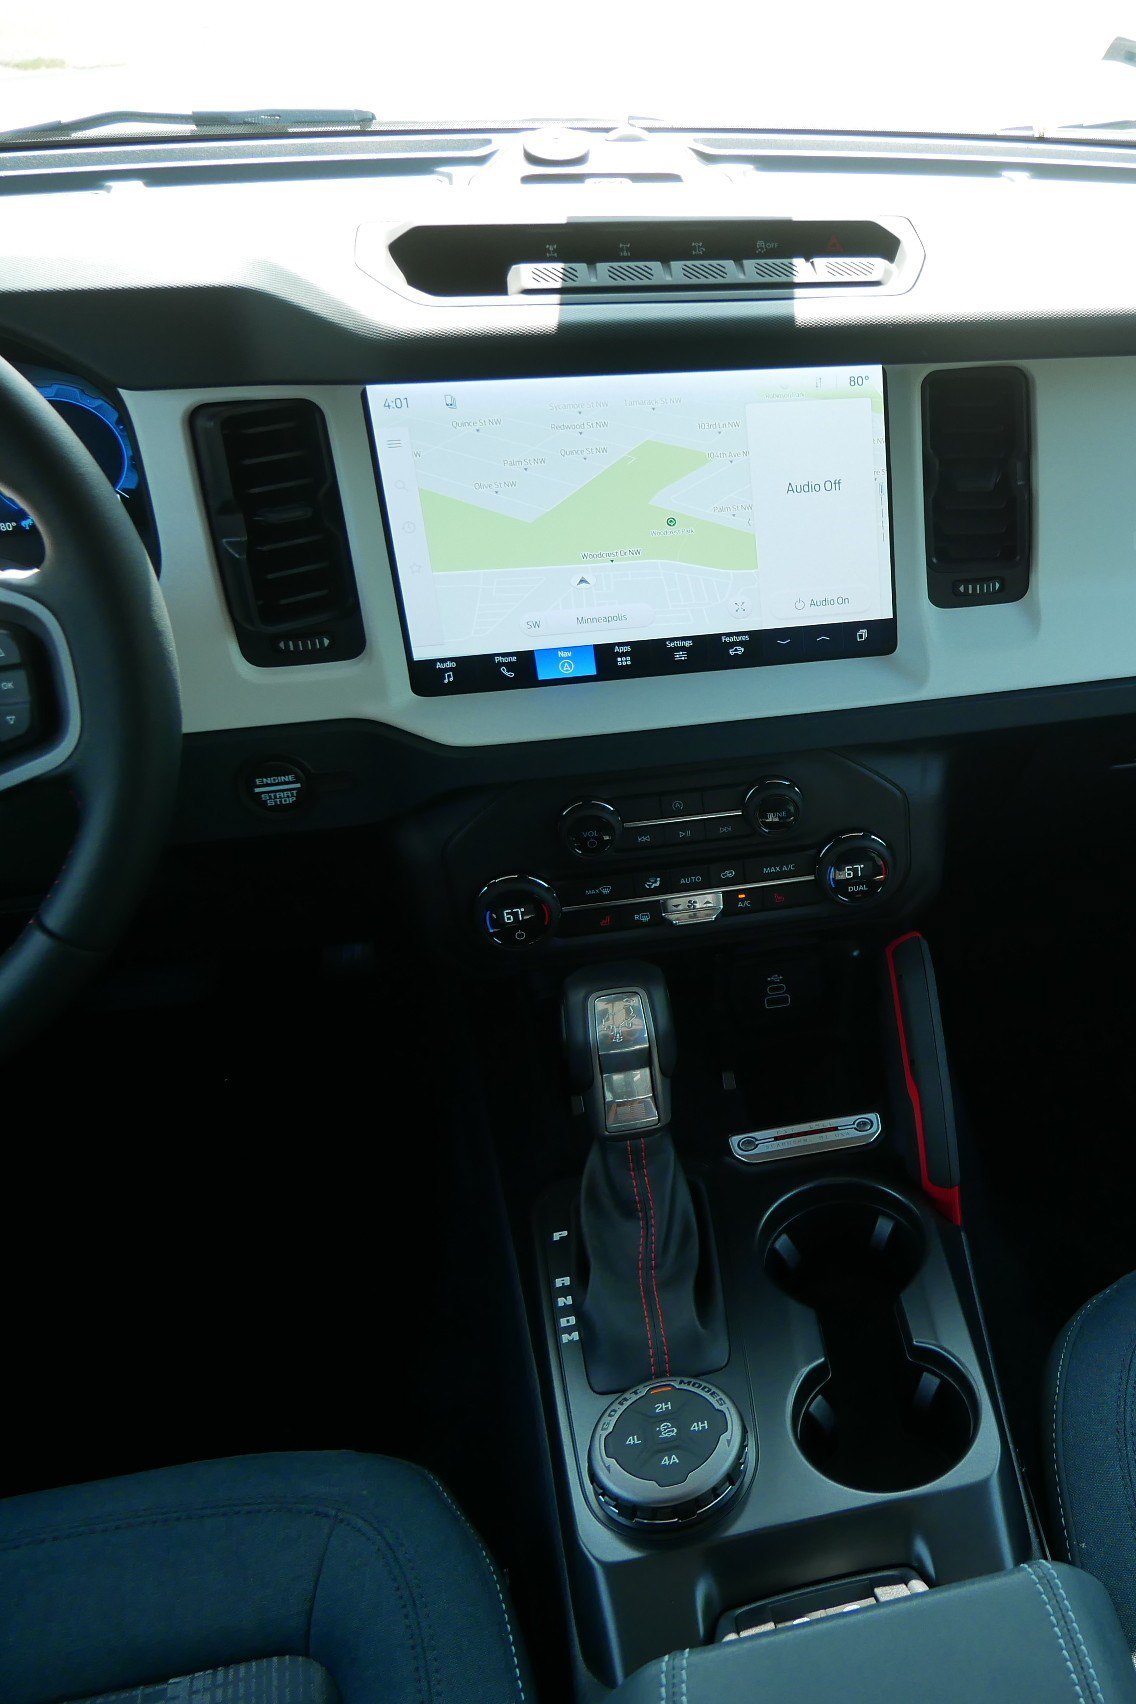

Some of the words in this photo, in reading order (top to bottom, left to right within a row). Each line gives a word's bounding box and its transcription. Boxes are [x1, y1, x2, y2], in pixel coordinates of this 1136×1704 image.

[849, 375, 869, 387] 80°
[383, 397, 409, 409] 4:01
[595, 400, 608, 408] NW
[451, 420, 477, 429] Quince
[489, 418, 501, 426] NW
[550, 422, 585, 431] Redwood
[698, 422, 716, 430] 103rd
[560, 448, 585, 457] Quince
[586, 447, 594, 455] St
[474, 482, 493, 490] Olive
[786, 481, 821, 495] Audio
[823, 479, 842, 492] Off
[713, 505, 732, 513] Palm
[0, 522, 17, 531] 80°
[809, 597, 835, 607] Audio
[836, 596, 850, 606] On
[576, 613, 628, 626] Minneapolis
[526, 621, 541, 630] SW
[721, 634, 749, 643] Features
[666, 639, 693, 648] Settings
[614, 645, 632, 653] Apps
[558, 650, 572, 658] Nav
[494, 655, 517, 664] Phone
[436, 660, 456, 669] Audio
[1, 682, 14, 690] OK
[256, 775, 296, 784] ENGINE
[262, 791, 297, 800] START
[766, 811, 787, 819] TUNE
[582, 830, 599, 838] VOL
[763, 866, 781, 874] MAX
[781, 864, 795, 872] A/C
[680, 875, 702, 884] AUTO
[848, 884, 868, 892] DUAL
[503, 908, 525, 923] 67°
[553, 1231, 568, 1241] P
[557, 1296, 573, 1307] N
[562, 1331, 579, 1343] M
[678, 1379, 727, 1407] MODES
[655, 1402, 672, 1413] 2H
[690, 1421, 709, 1431] 4H
[626, 1435, 642, 1445] 4L
[661, 1454, 679, 1465] 4A
